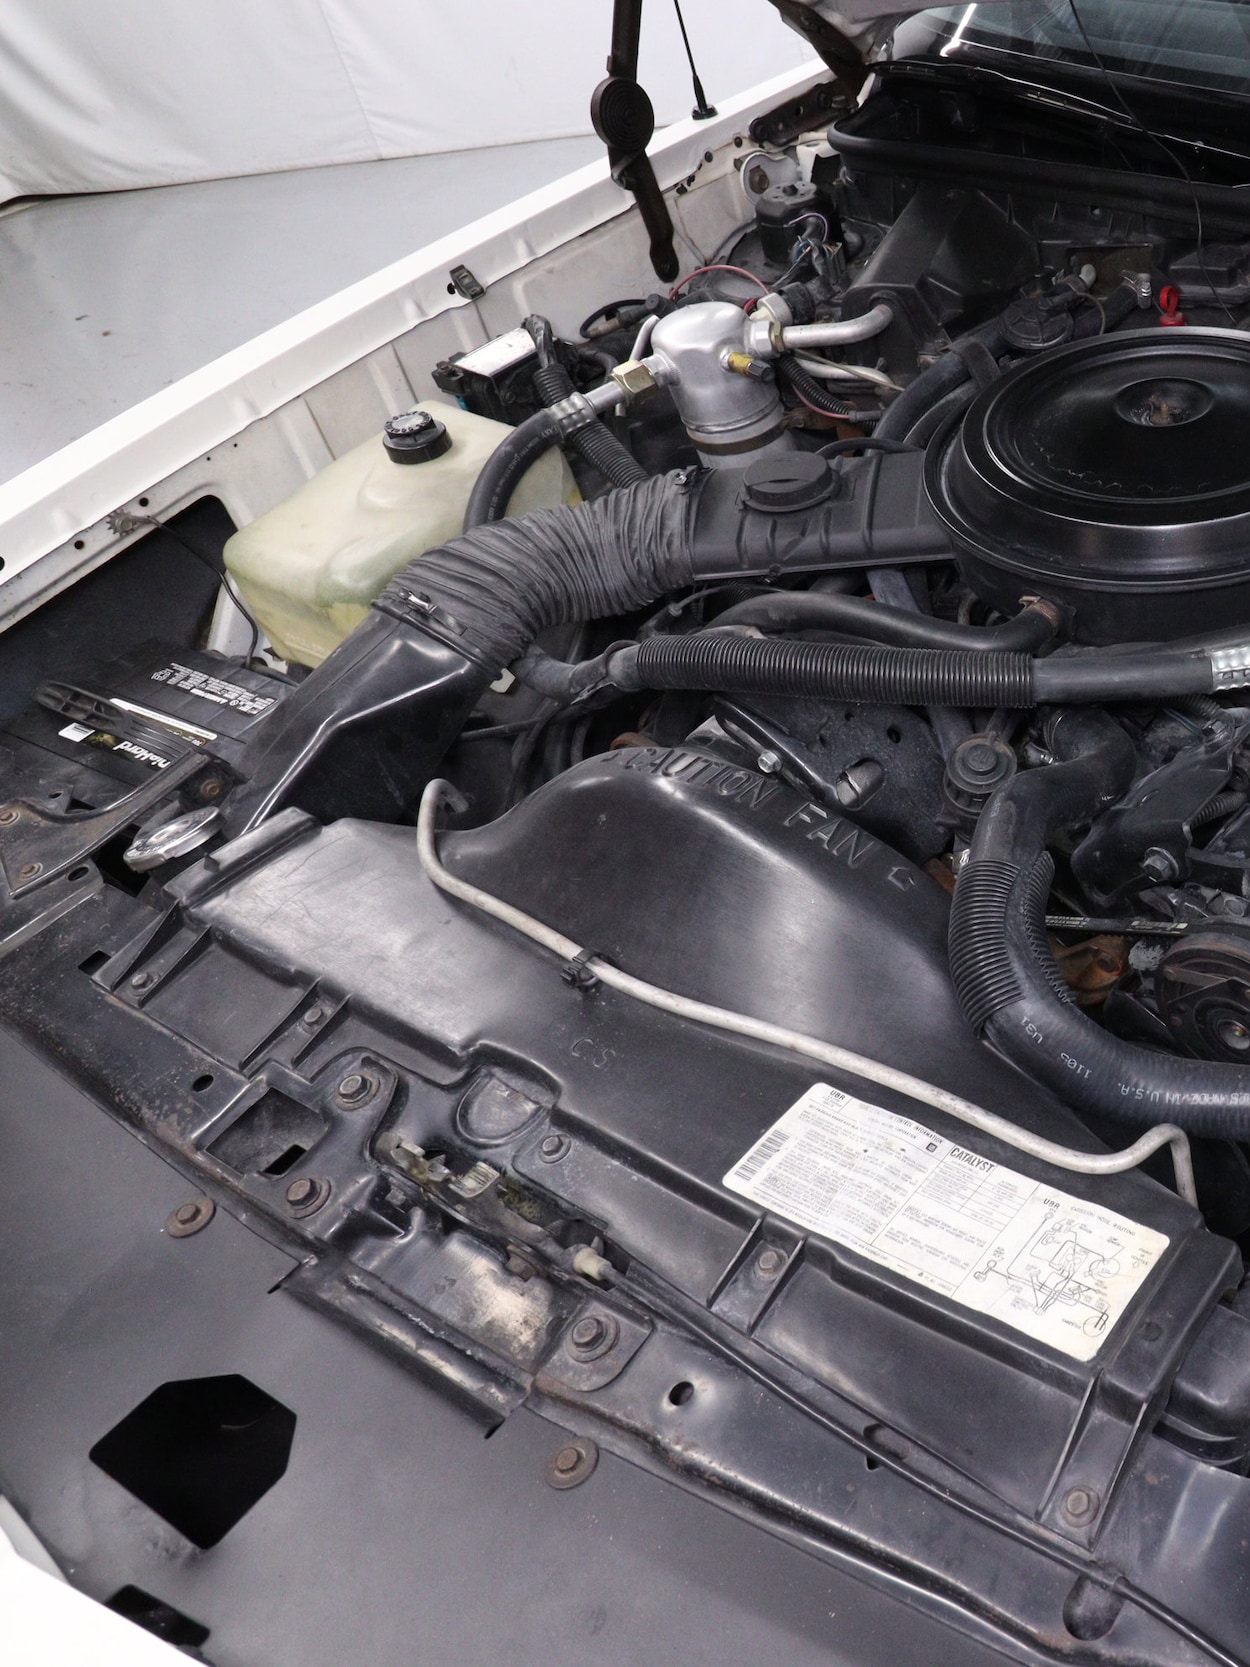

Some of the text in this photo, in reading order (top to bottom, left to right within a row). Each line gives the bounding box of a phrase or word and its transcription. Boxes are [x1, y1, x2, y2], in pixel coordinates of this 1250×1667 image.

[622, 747, 781, 810] CAUTION
[783, 802, 878, 870] FAN
[829, 1089, 846, 1101] UBR
[1117, 1082, 1160, 1103] U.S.A.
[1165, 1092, 1182, 1105] IN
[1190, 1092, 1224, 1105] MADE
[949, 1145, 997, 1175] CATALYST
